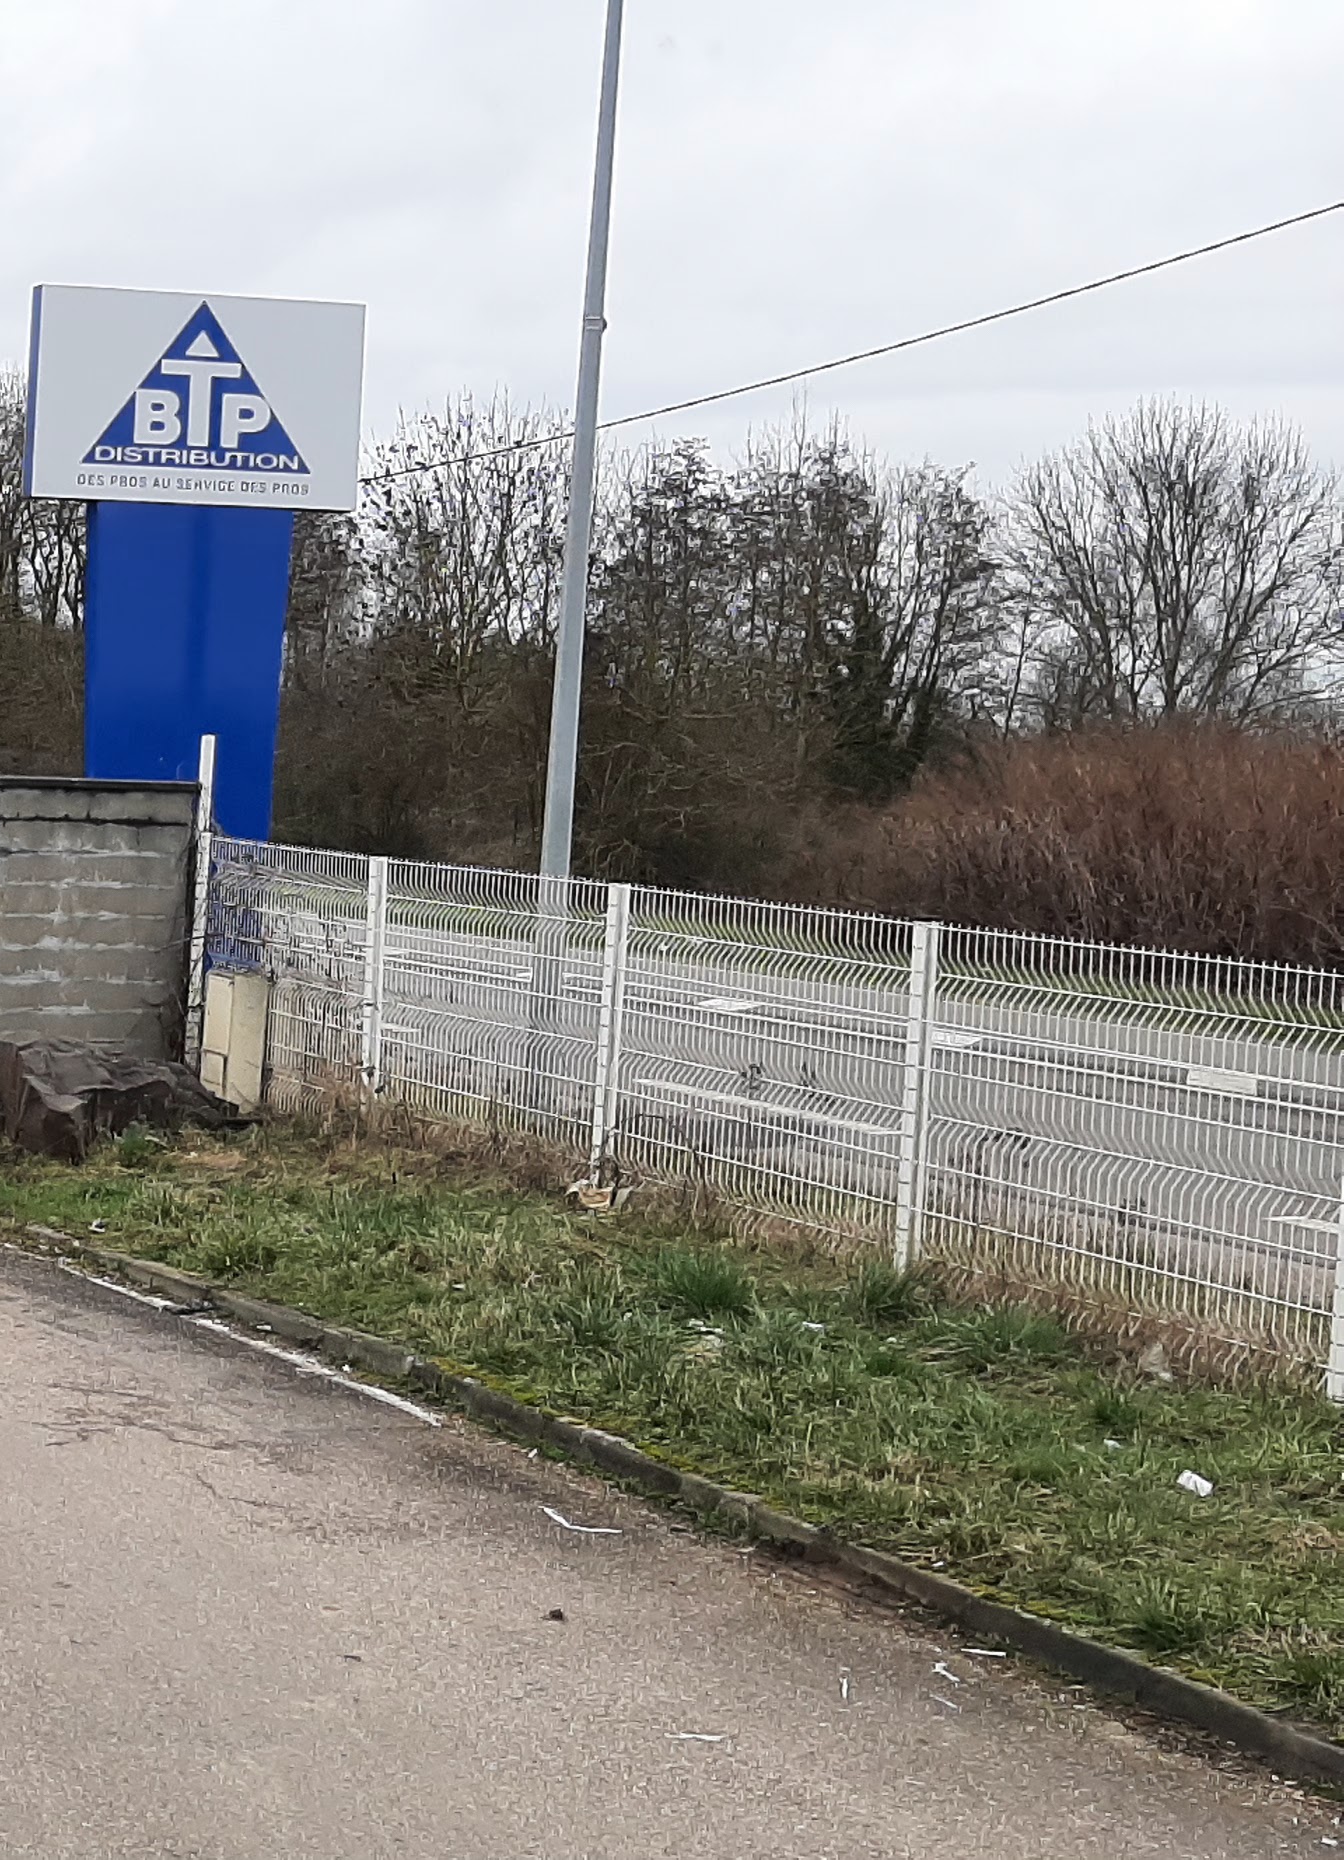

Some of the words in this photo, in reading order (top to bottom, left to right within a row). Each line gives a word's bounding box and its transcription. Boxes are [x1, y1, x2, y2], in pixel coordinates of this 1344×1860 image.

[133, 359, 271, 449] BTP
[94, 446, 299, 470] DISTRIBUTION
[77, 474, 105, 486] DES
[153, 477, 171, 489] AU
[176, 478, 236, 492] SERVICE
